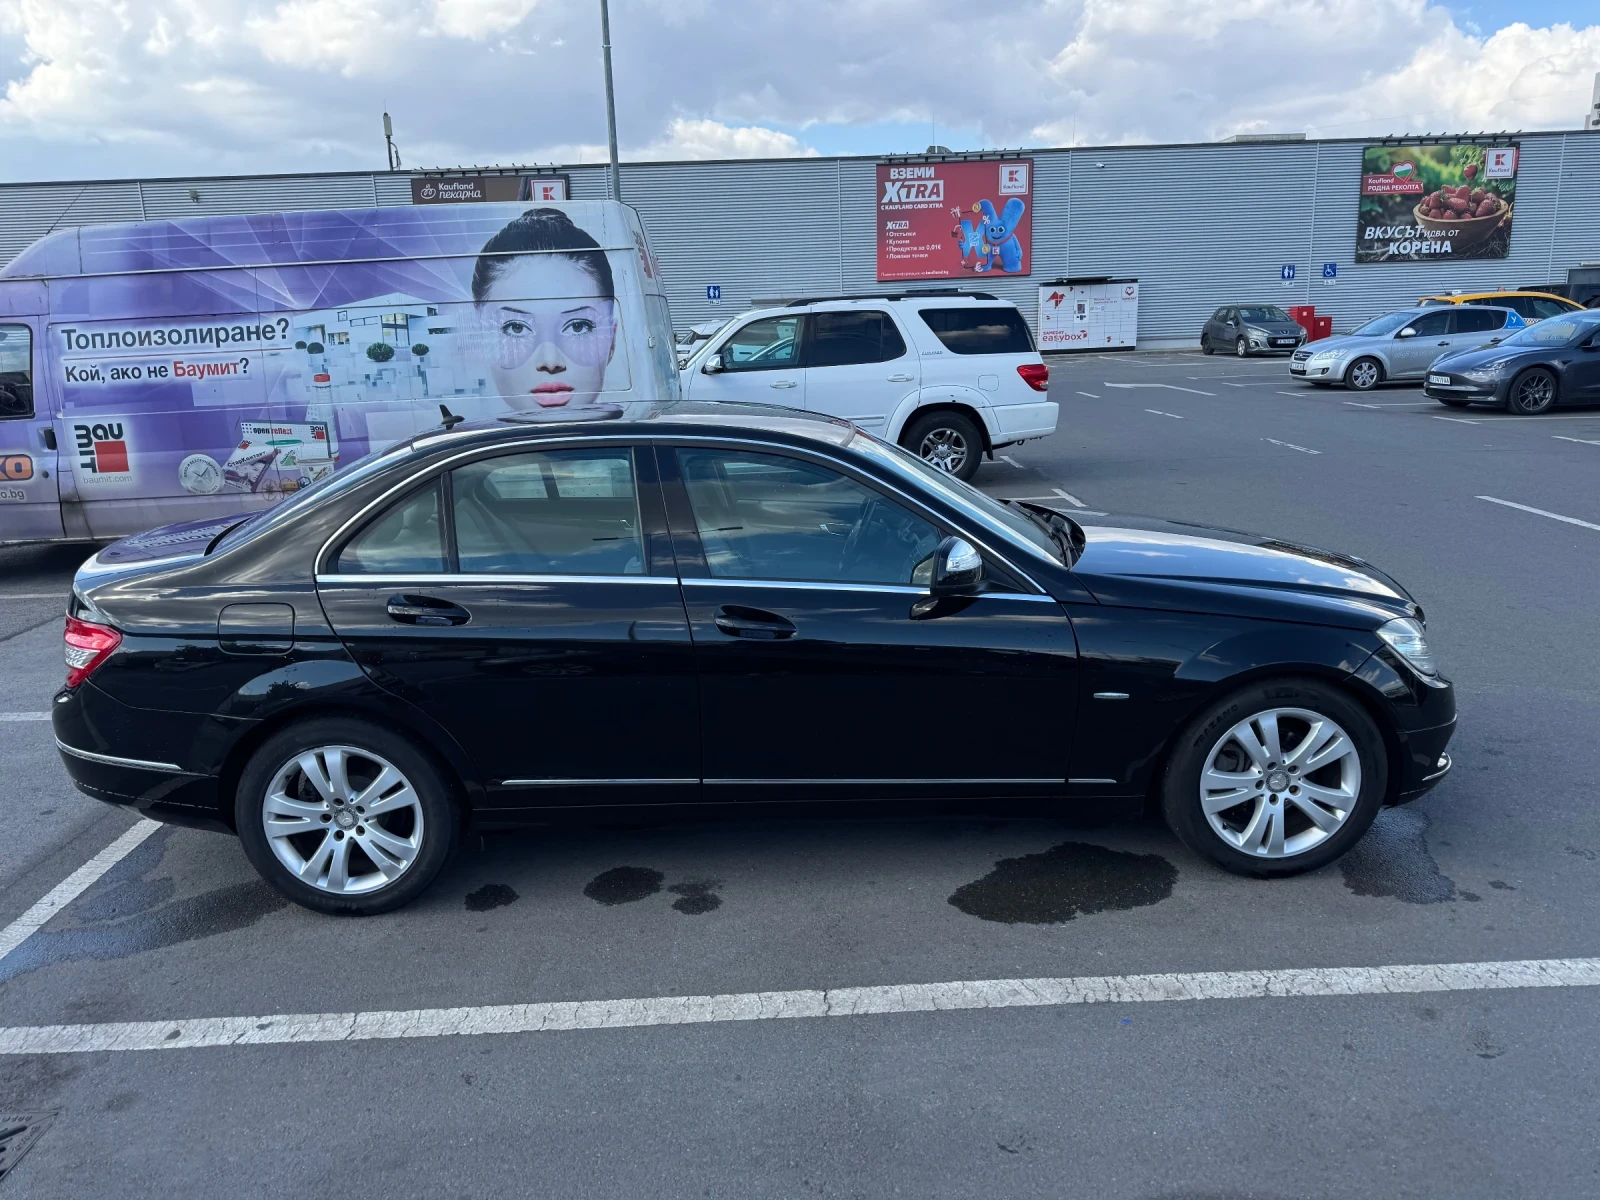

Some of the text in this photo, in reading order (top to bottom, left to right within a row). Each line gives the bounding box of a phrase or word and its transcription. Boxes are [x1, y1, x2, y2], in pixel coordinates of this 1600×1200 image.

[890, 167, 935, 179] ВЗЕМИ
[438, 182, 474, 191] Kaufland
[881, 180, 943, 203] XTRA
[1367, 184, 1391, 192] РОДНА
[439, 189, 482, 200] пекарна
[886, 221, 909, 229] XTRA
[1364, 225, 1460, 240] ВКУСЪТ ИДВА ОТ
[1389, 241, 1452, 255] КОРЕНА
[61, 317, 290, 350] Топлоизолиране?
[1042, 332, 1082, 342] easybox
[65, 357, 250, 384] Кой, ако не Баумит?
[83, 475, 133, 484] baumit.com
[0, 489, 25, 500] o.bg
